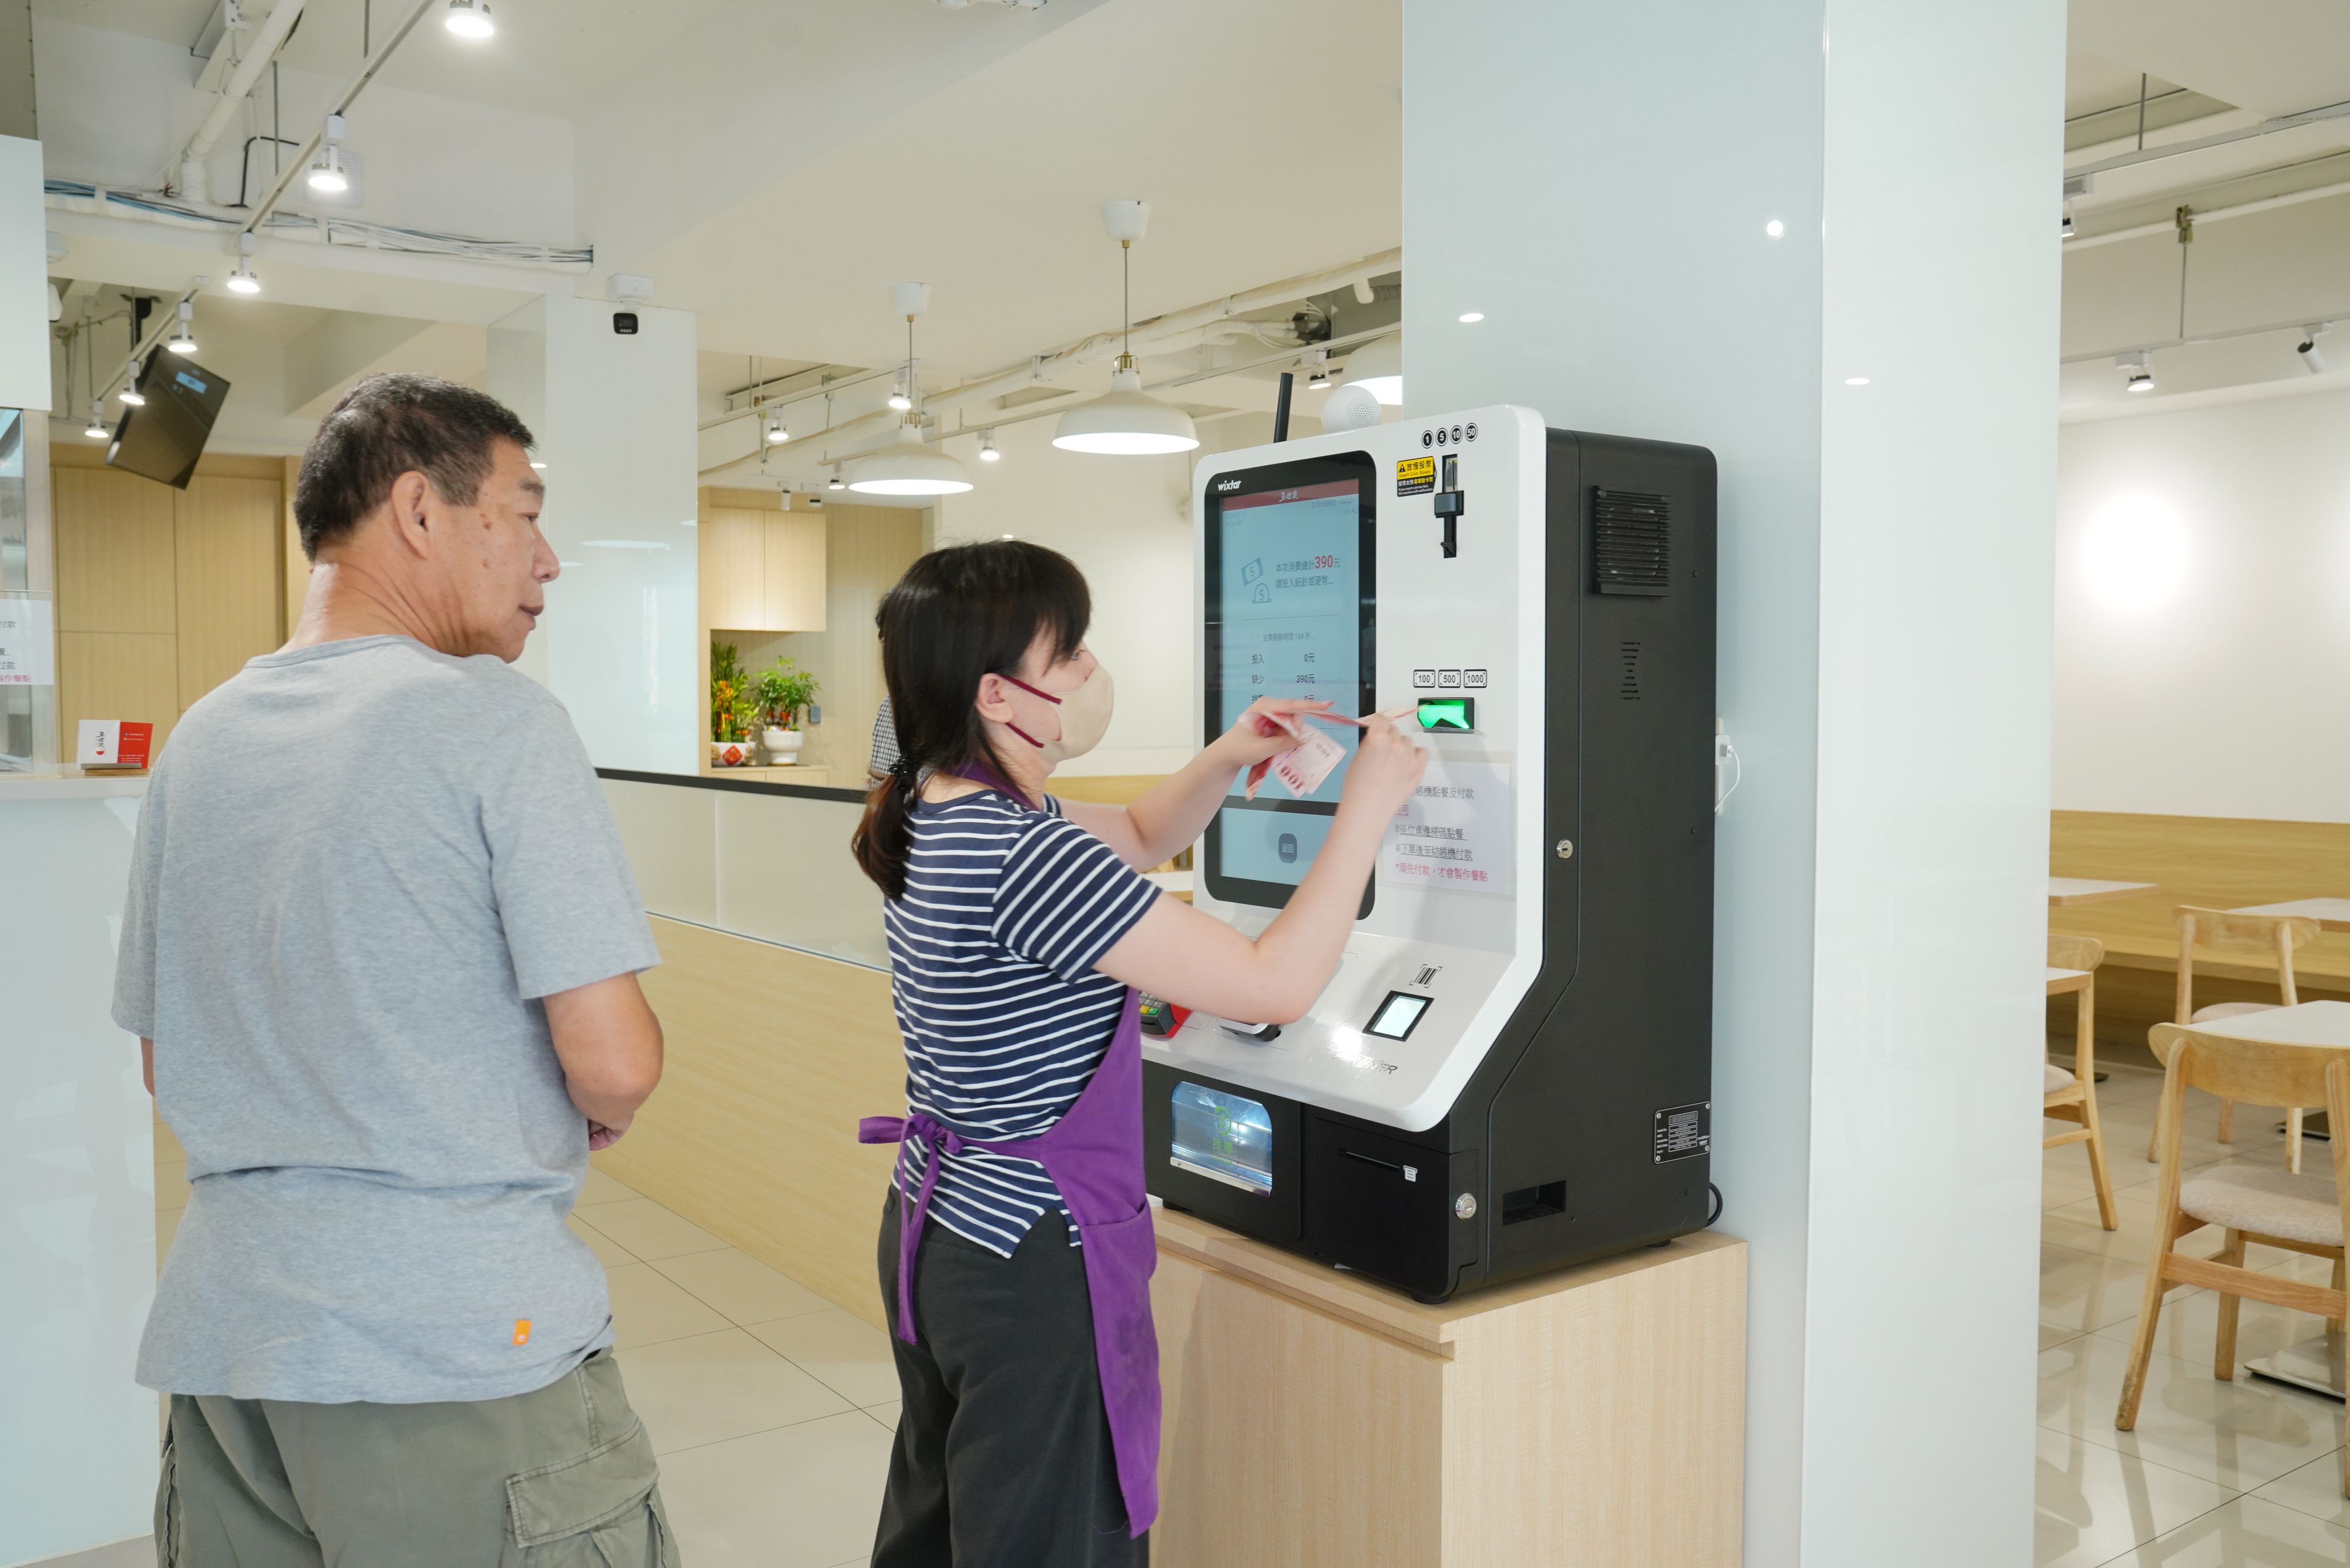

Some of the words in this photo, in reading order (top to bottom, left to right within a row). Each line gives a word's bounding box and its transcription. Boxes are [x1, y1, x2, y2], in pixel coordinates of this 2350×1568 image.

[1439, 433, 1444, 441] 5
[1452, 430, 1461, 439] 10
[1467, 428, 1475, 437] 50
[1406, 460, 1431, 471] 放慢投幣
[1217, 479, 1241, 491] wixtar
[1275, 555, 1340, 572] 本次消費總計390元
[1252, 654, 1265, 664] 投入
[1304, 653, 1315, 663] 0元
[1252, 674, 1265, 684] 缺少
[1296, 674, 1315, 684] 390元
[1418, 674, 1431, 683] 100
[1443, 674, 1456, 683] 500
[1467, 674, 1484, 683] 1000
[1411, 785, 1475, 800] 帳機點餐及付款
[1282, 843, 1294, 853] 返回
